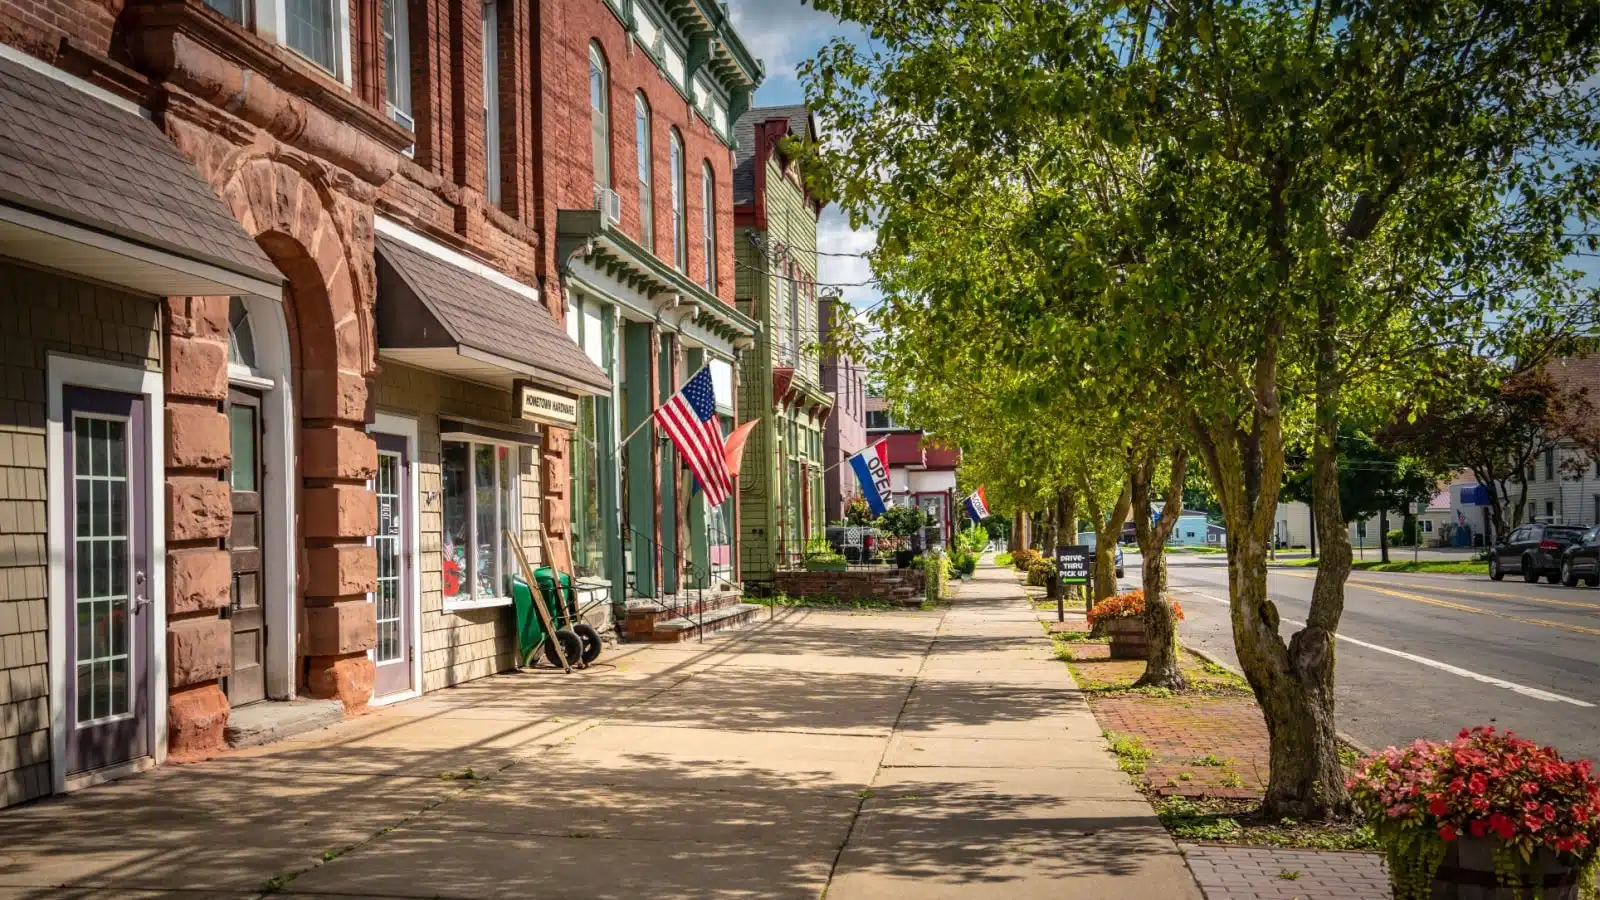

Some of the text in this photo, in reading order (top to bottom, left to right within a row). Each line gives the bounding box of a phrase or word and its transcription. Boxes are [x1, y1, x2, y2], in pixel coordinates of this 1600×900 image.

[526, 394, 574, 416] HOMETOWN HARDWARE
[867, 457, 892, 503] OPEN
